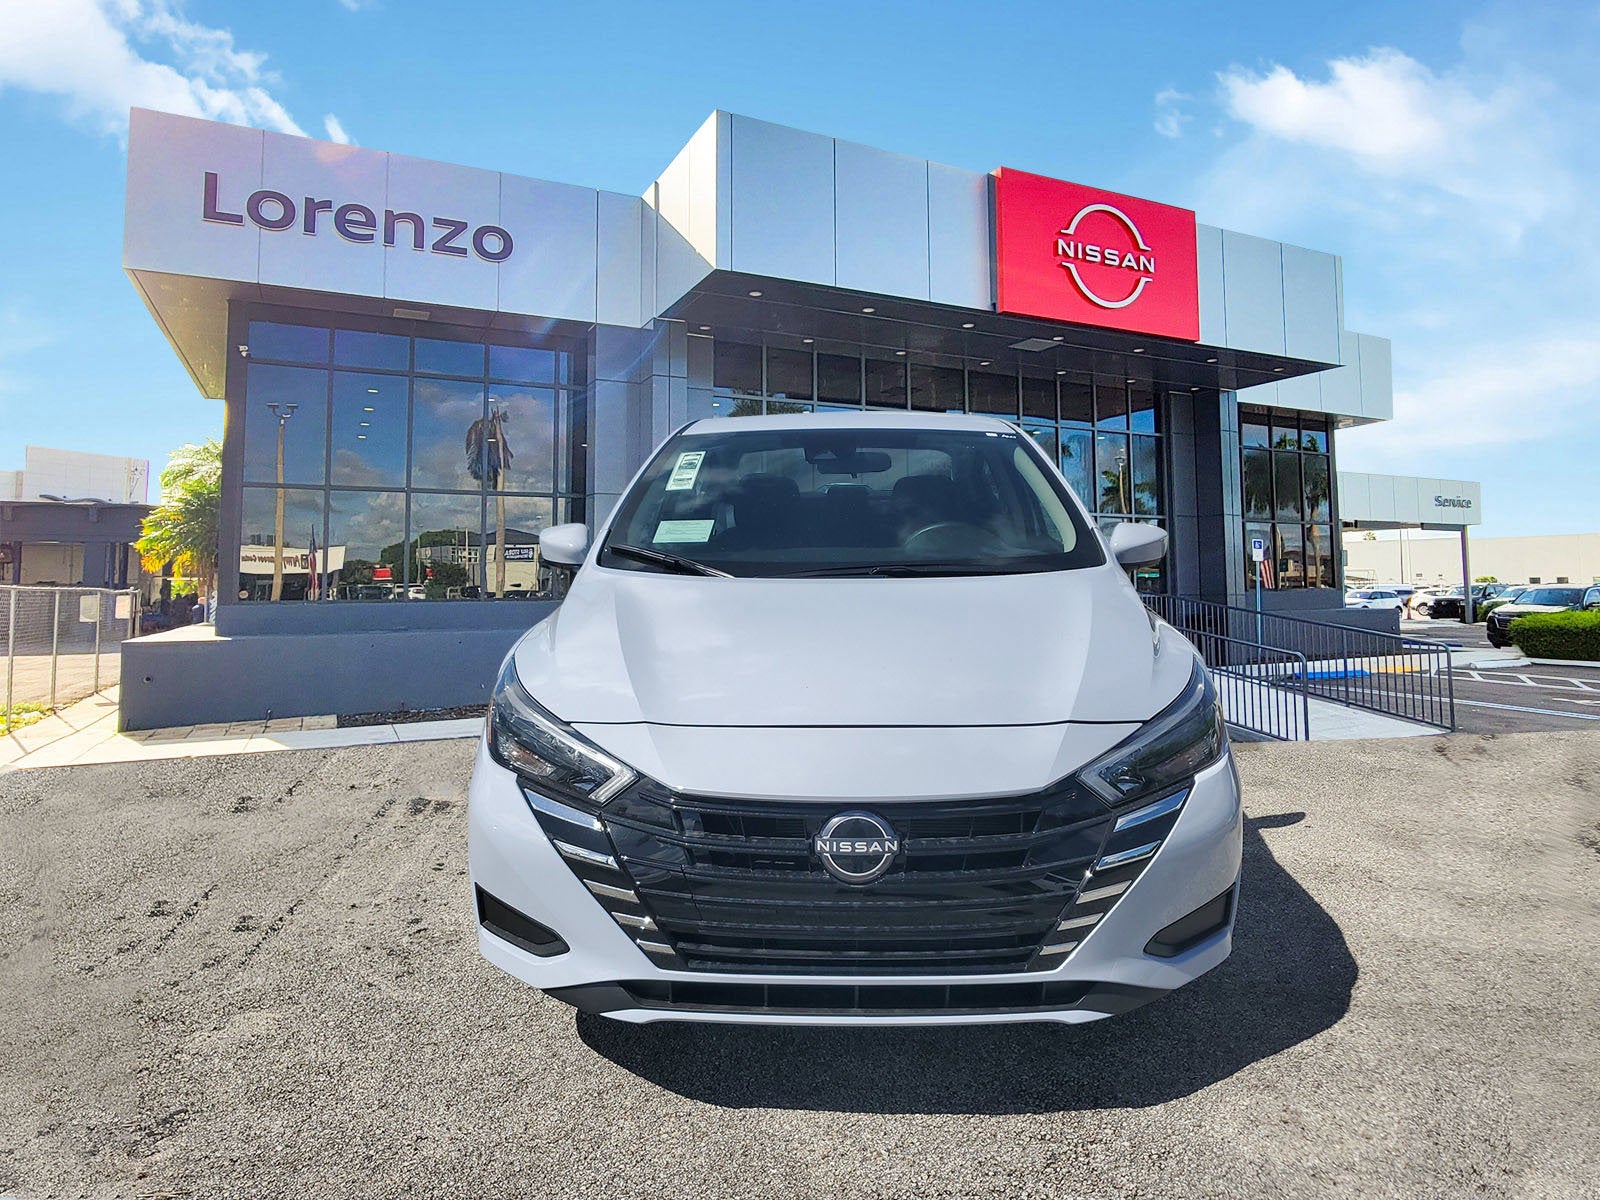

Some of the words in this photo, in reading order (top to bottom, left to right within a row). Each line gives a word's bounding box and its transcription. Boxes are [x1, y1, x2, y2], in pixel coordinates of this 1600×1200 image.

[202, 171, 514, 262] Lorenzo
[1057, 238, 1155, 273] NISSAN
[1434, 495, 1472, 508] Service
[817, 840, 898, 853] NISSAN
